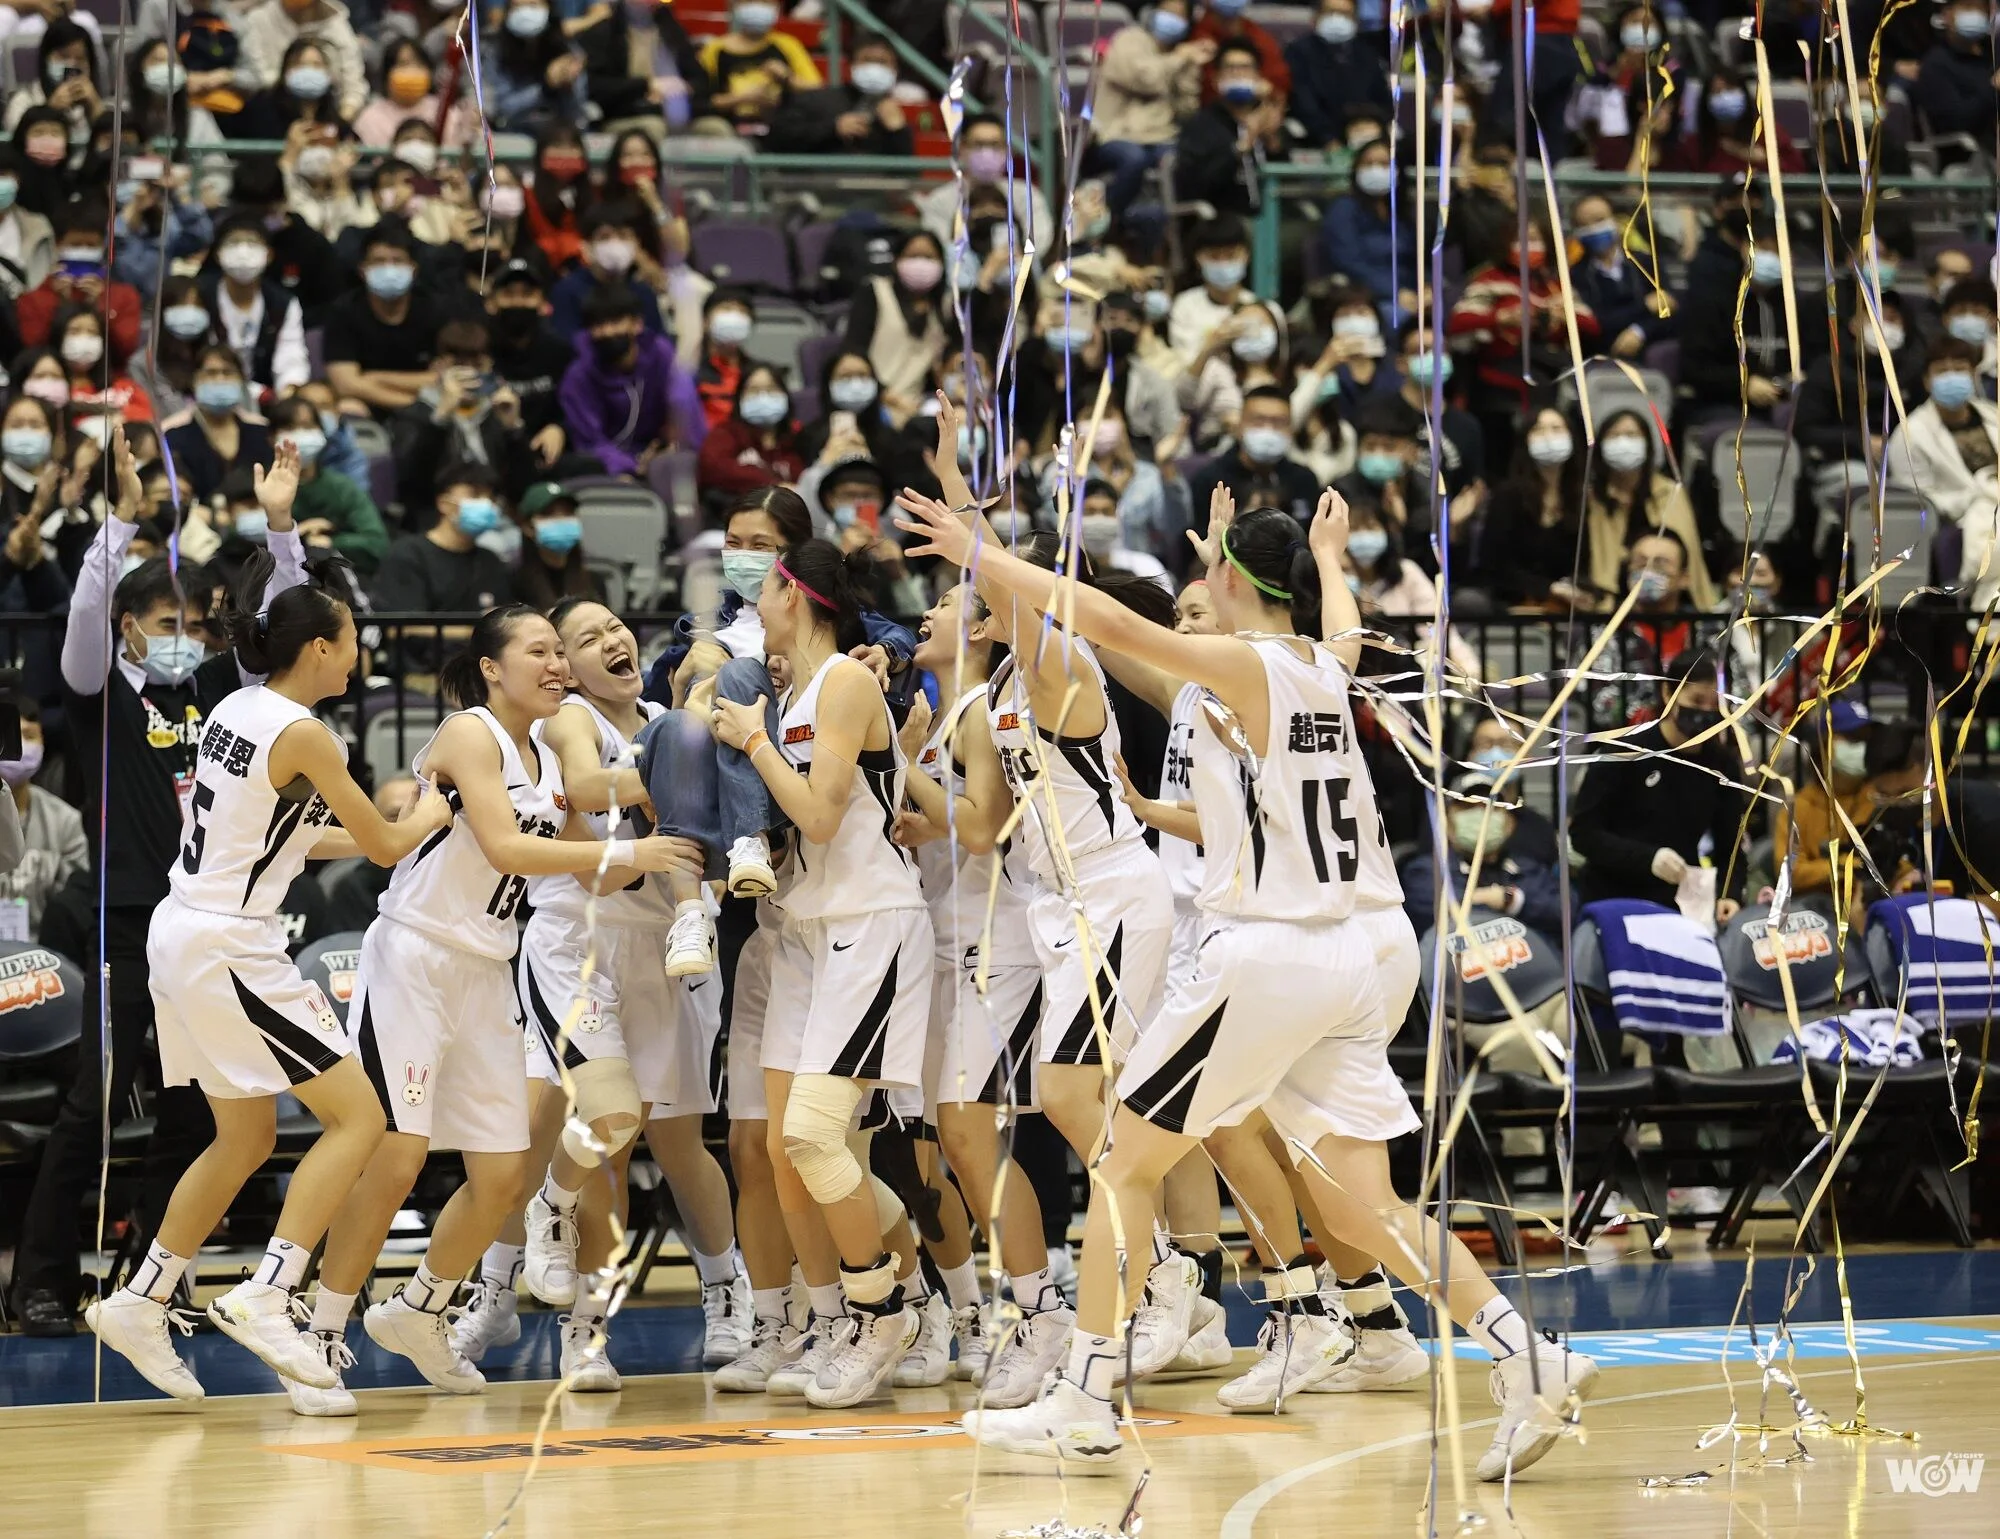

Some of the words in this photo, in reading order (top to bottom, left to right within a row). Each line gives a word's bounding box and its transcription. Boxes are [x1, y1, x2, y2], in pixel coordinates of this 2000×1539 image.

[183, 780, 215, 875] 5
[1302, 777, 1359, 883] 15
[486, 874, 527, 920] 13
